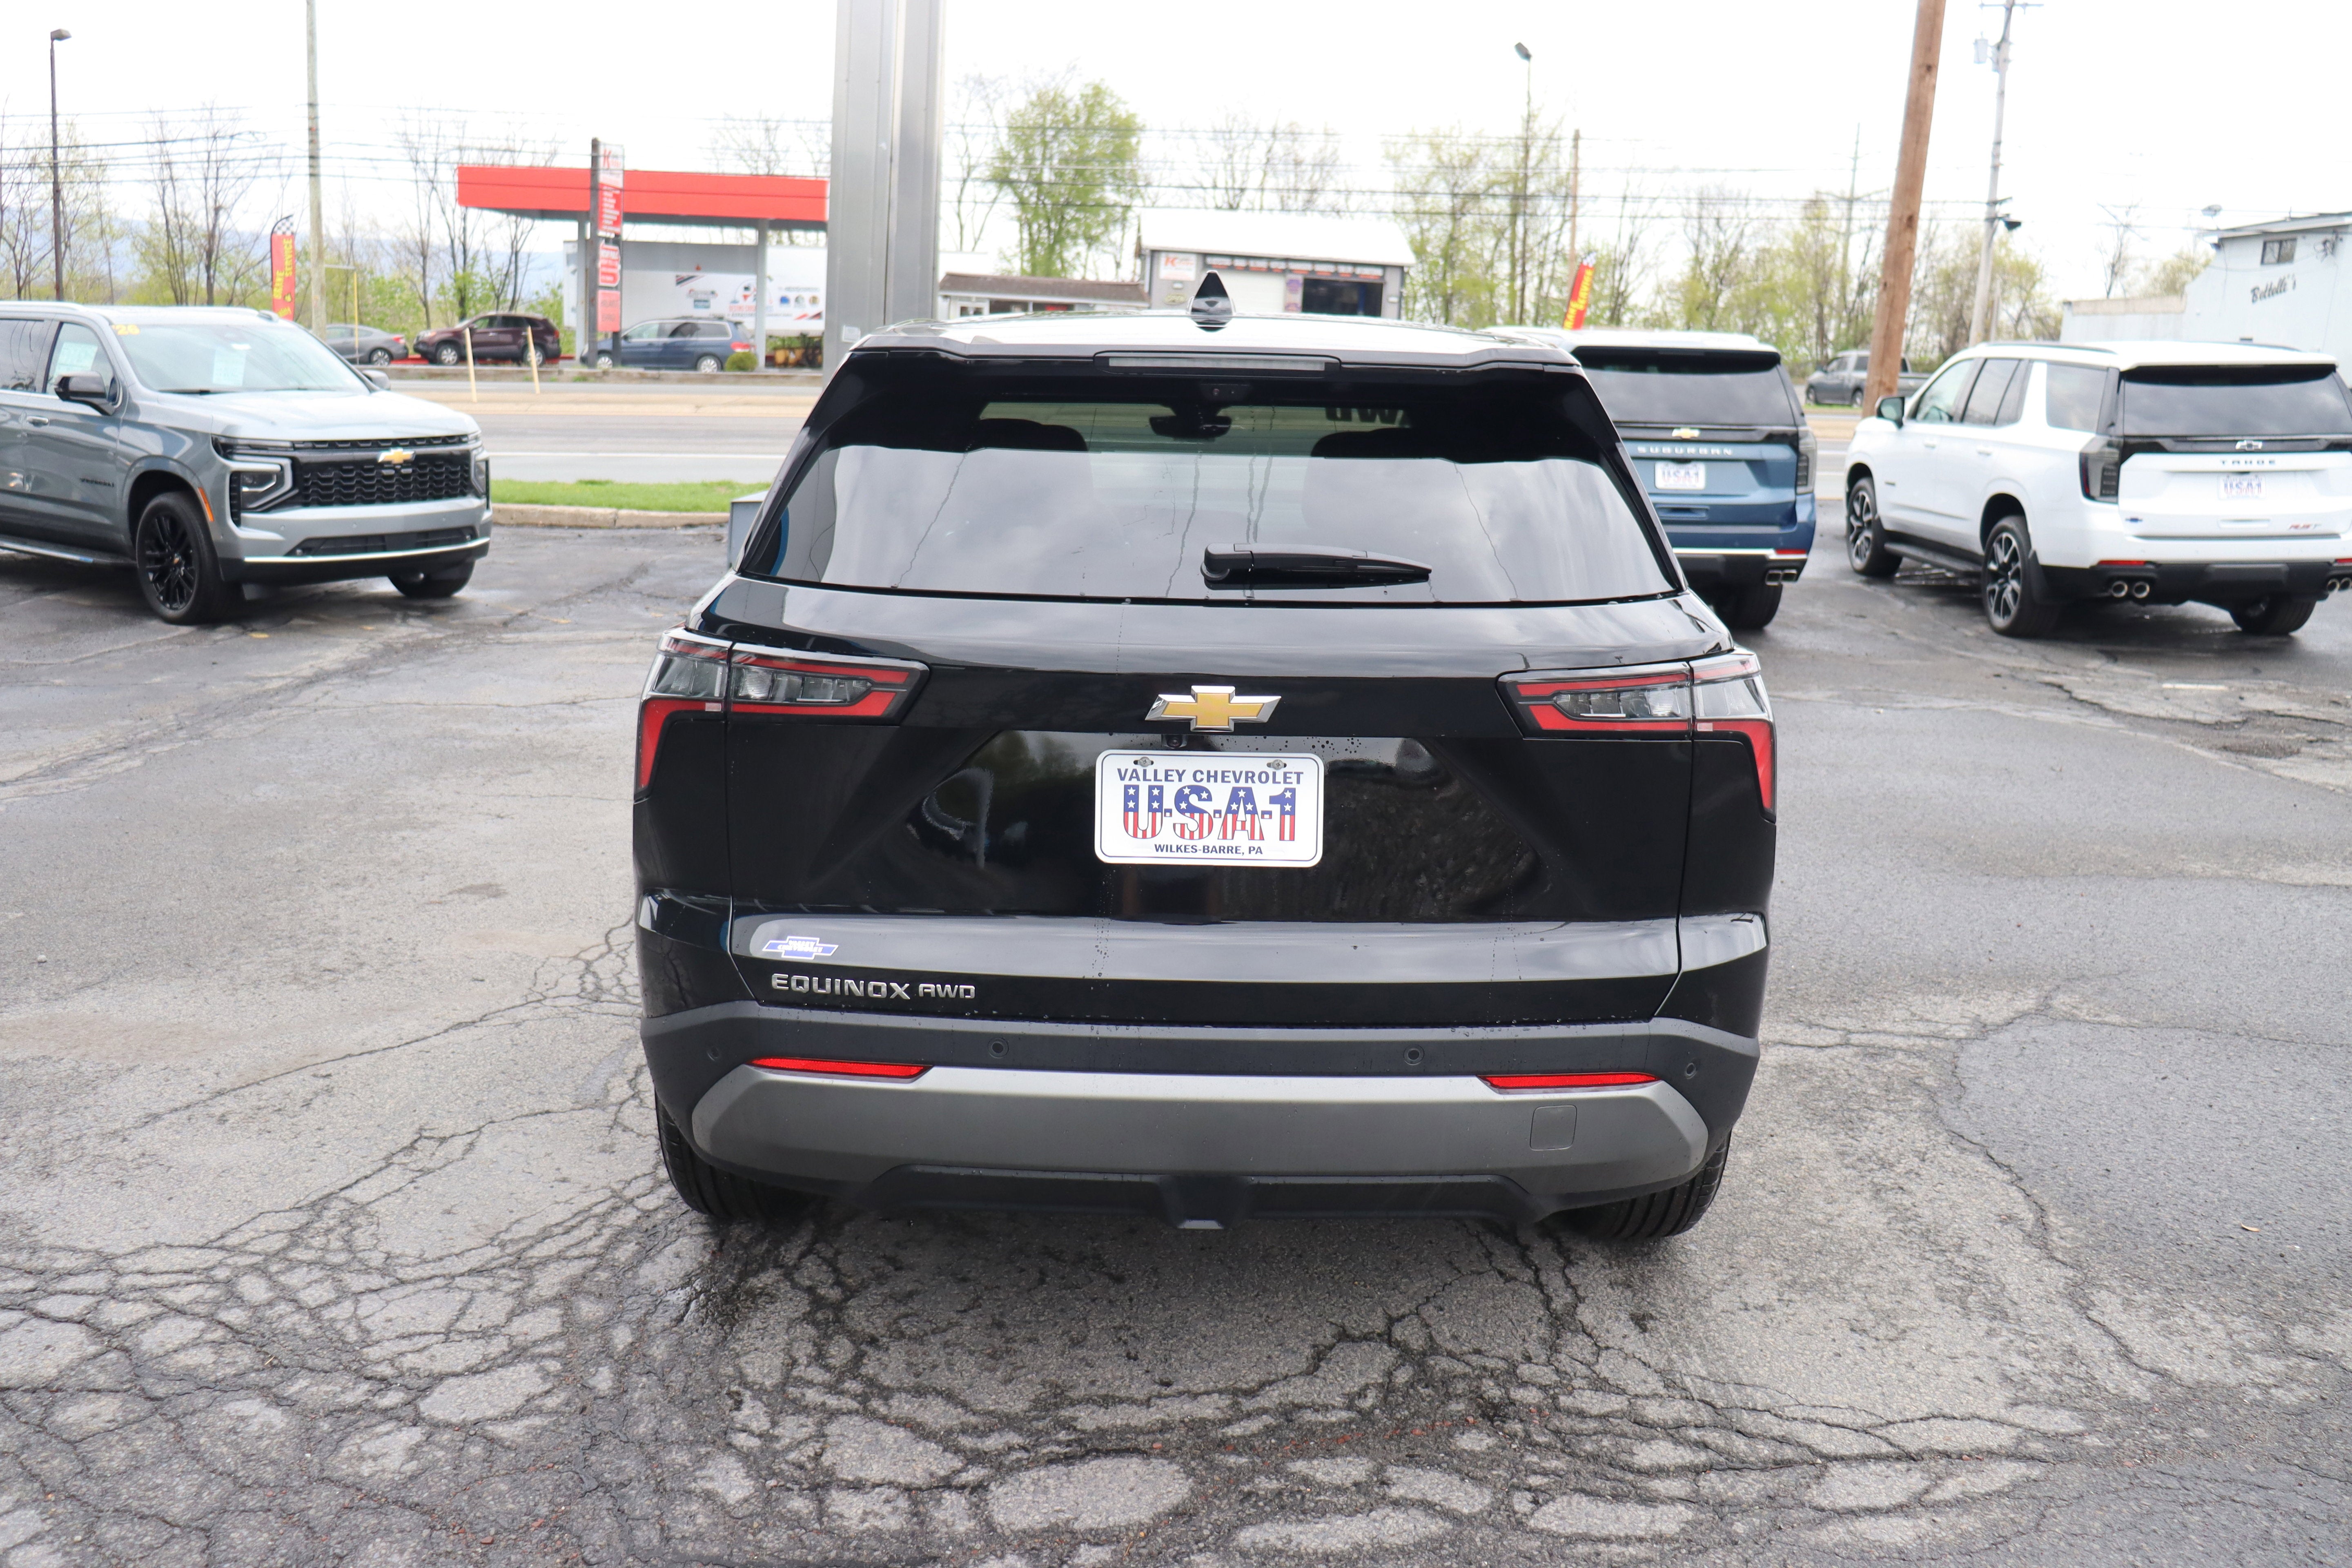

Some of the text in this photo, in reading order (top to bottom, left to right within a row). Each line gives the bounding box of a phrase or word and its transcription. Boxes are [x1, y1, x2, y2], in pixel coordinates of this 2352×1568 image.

[1637, 445, 1733, 455] SUBURBAN
[1117, 768, 1304, 784] VALLEY CHEVROLET
[1154, 844, 1263, 855] WILKES-BARRE, PA
[771, 973, 975, 1000] EQUINOX AWD
